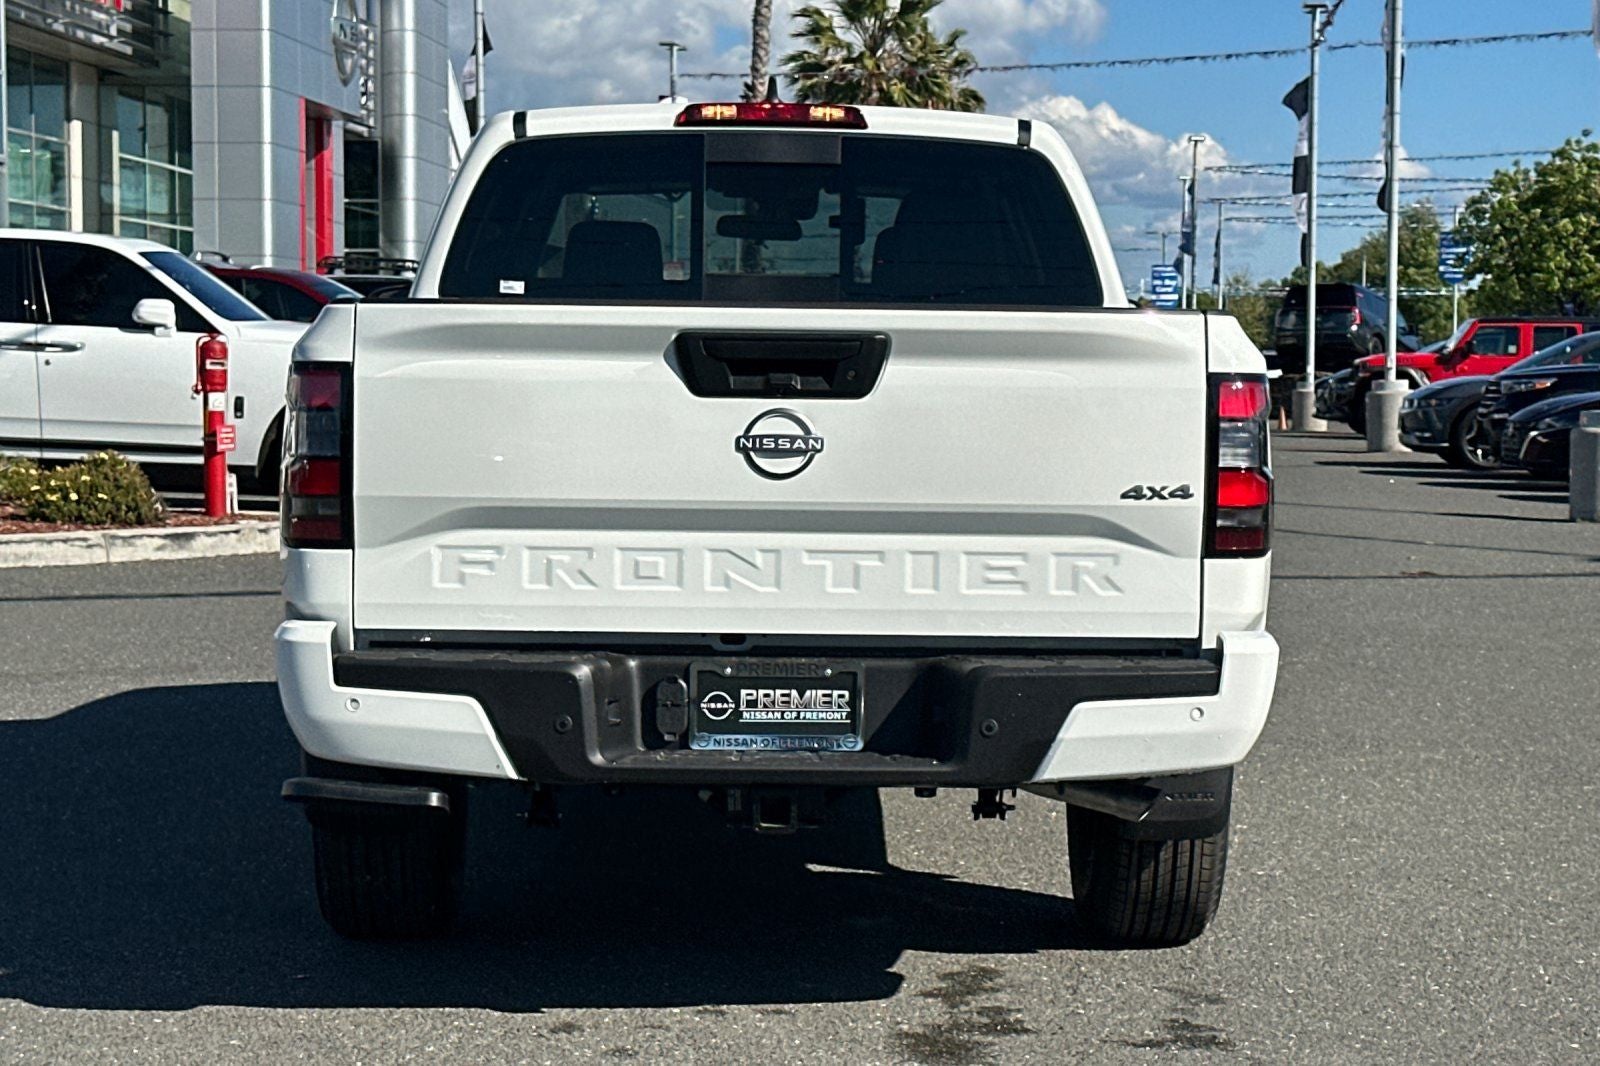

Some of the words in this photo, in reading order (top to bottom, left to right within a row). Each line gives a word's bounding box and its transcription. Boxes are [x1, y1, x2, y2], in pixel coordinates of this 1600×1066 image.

[739, 437, 822, 449] NISSAN
[430, 544, 1125, 597] FRONTIER
[736, 663, 821, 675] PREMIER
[740, 688, 850, 709] PREMIER
[742, 711, 781, 720] NISSAN
[783, 711, 798, 720] OF
[799, 711, 848, 720] FREMONT
[713, 738, 758, 747] NISSAN
